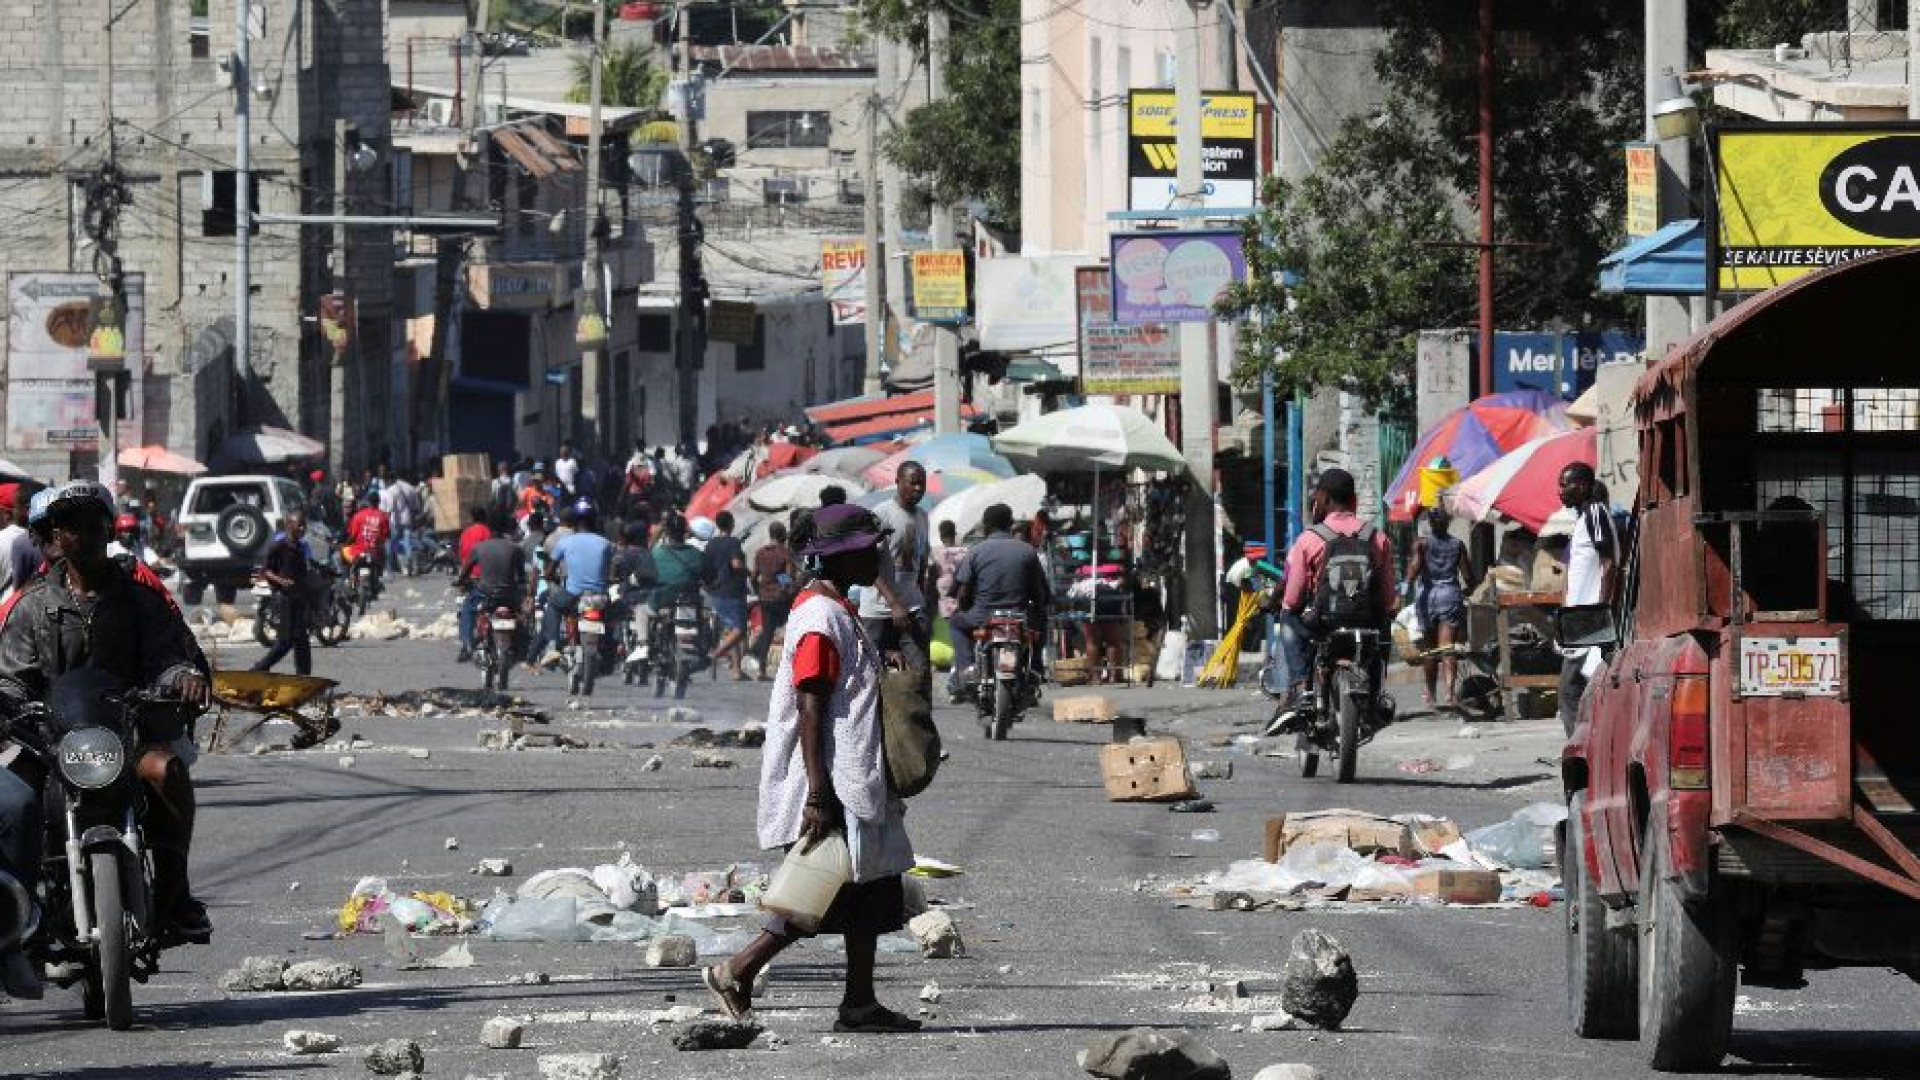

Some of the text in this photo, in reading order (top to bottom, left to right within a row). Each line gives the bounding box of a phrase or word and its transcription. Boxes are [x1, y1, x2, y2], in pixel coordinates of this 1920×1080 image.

[1200, 146, 1243, 159] estern
[1835, 164, 1920, 213] CA
[1747, 250, 1803, 264] KALITE
